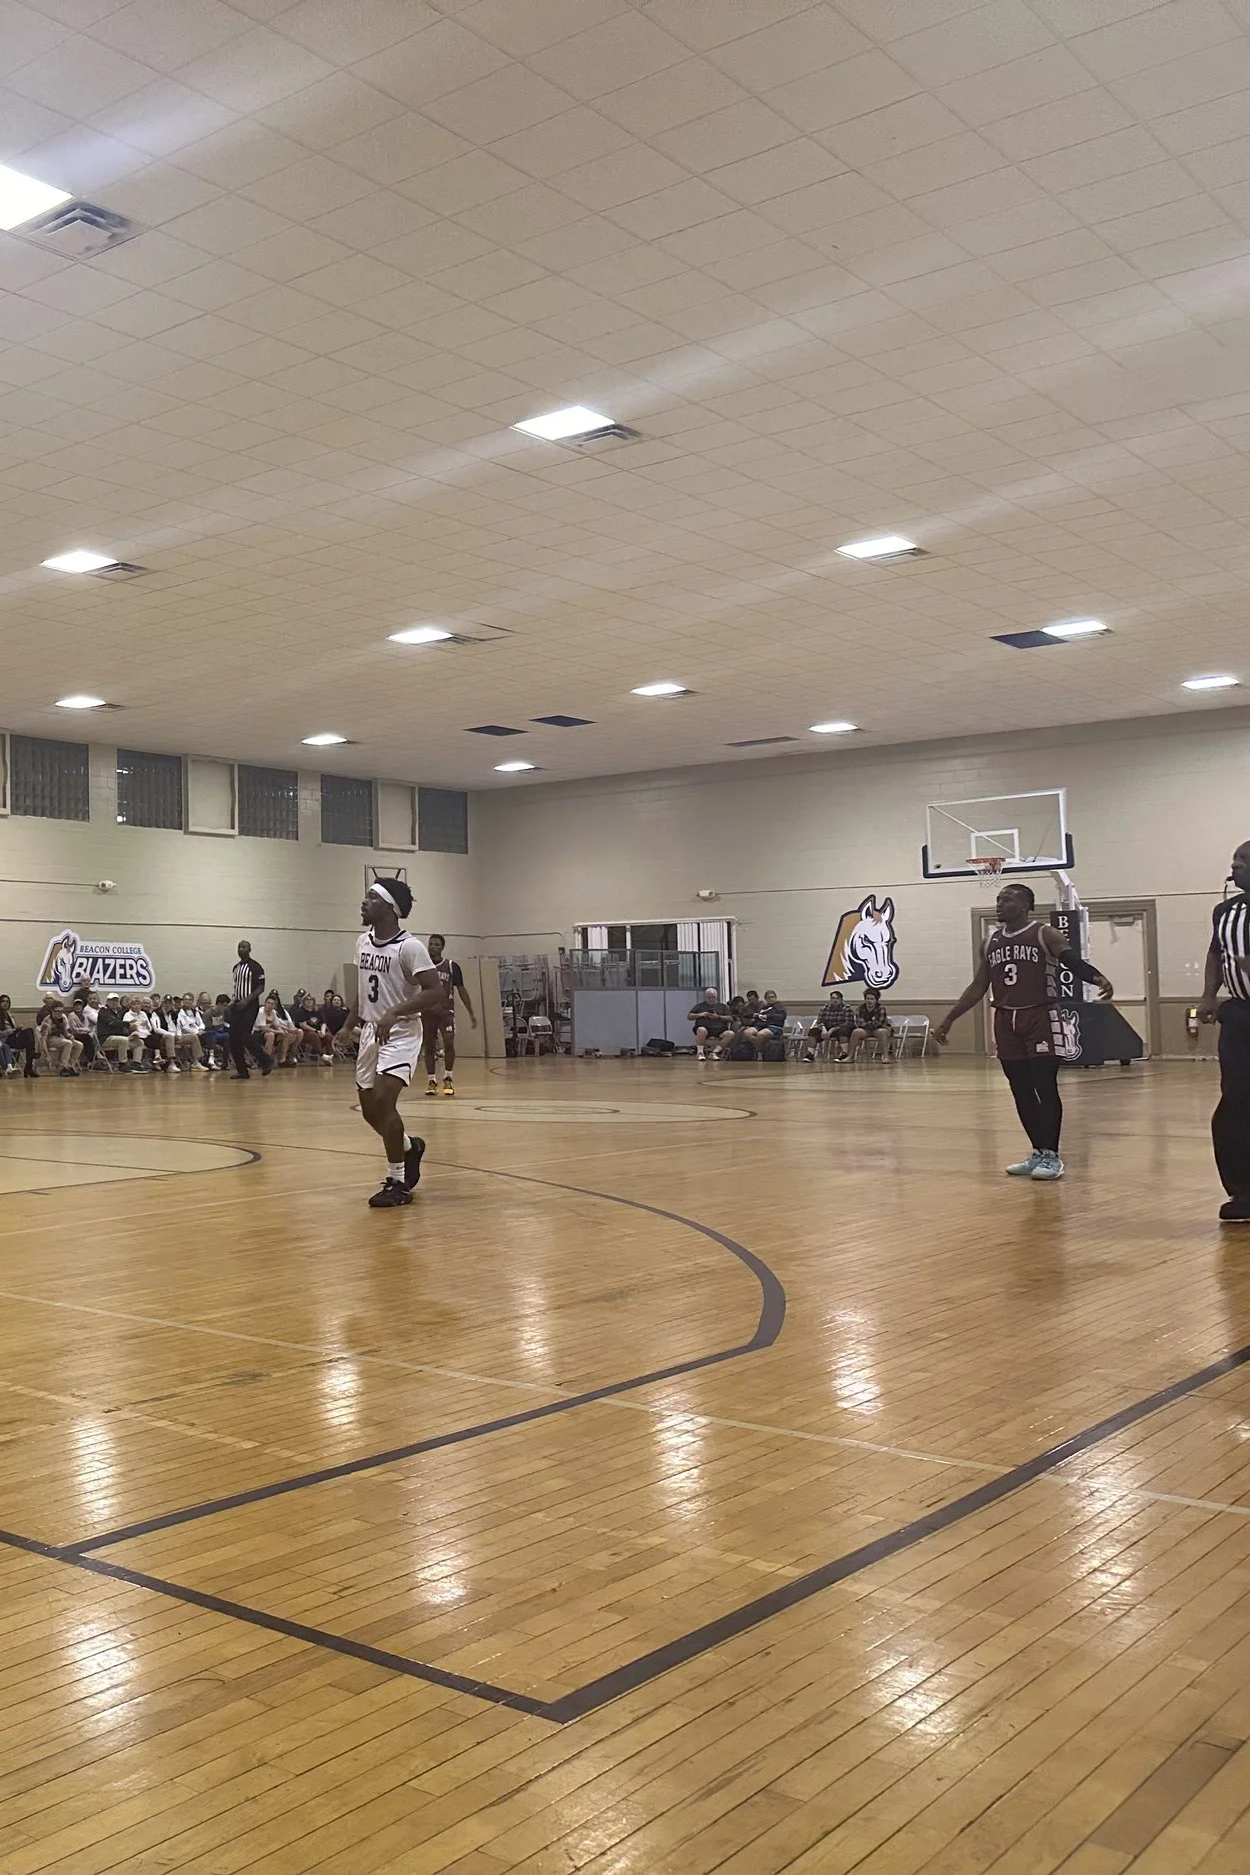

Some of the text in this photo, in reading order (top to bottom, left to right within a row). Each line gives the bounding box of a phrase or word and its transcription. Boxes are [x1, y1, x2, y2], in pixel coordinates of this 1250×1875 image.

[80, 945, 142, 955] BEACON COLLEGE
[988, 945, 1039, 968] EAGLE RAYS
[72, 957, 151, 986] BLAZERS
[359, 952, 392, 974] BEACON
[1004, 963, 1018, 986] 3
[368, 974, 379, 1003] 3
